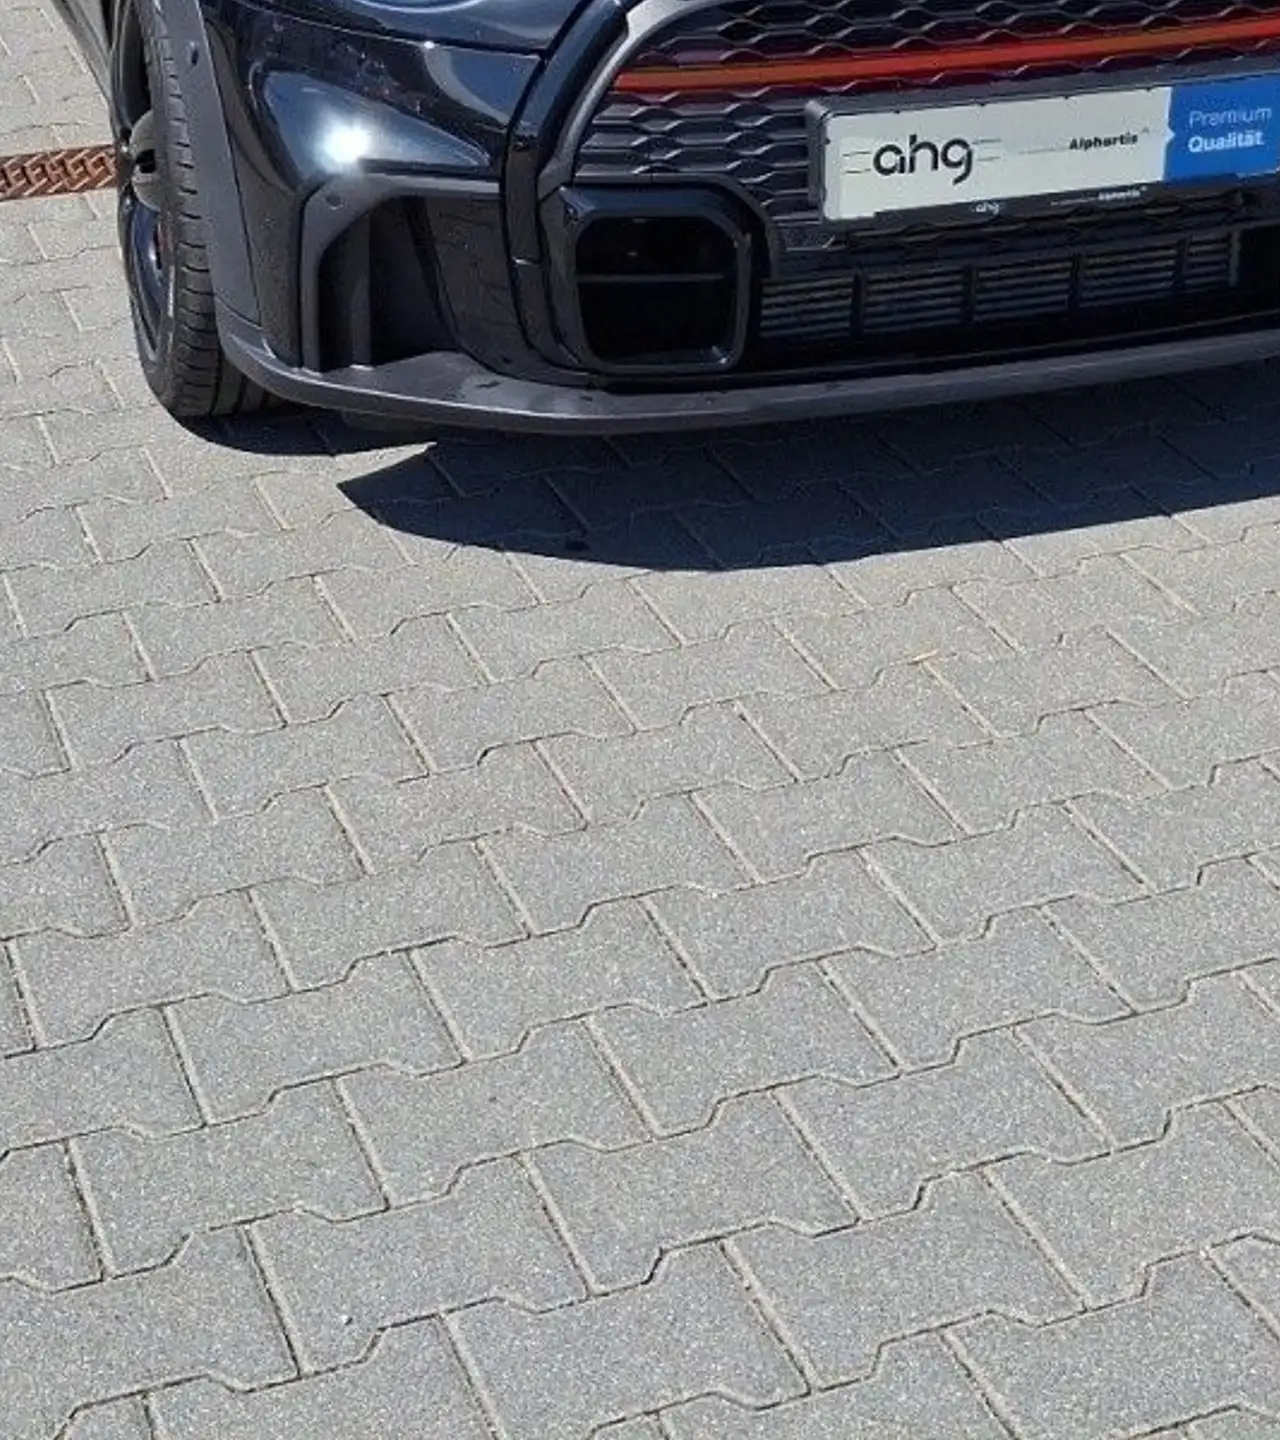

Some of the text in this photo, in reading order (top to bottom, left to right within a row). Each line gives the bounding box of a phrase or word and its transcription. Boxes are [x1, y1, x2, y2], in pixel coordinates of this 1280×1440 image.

[1188, 107, 1273, 128] Premium
[1187, 129, 1266, 153] Qualität
[873, 134, 974, 186] ahg
